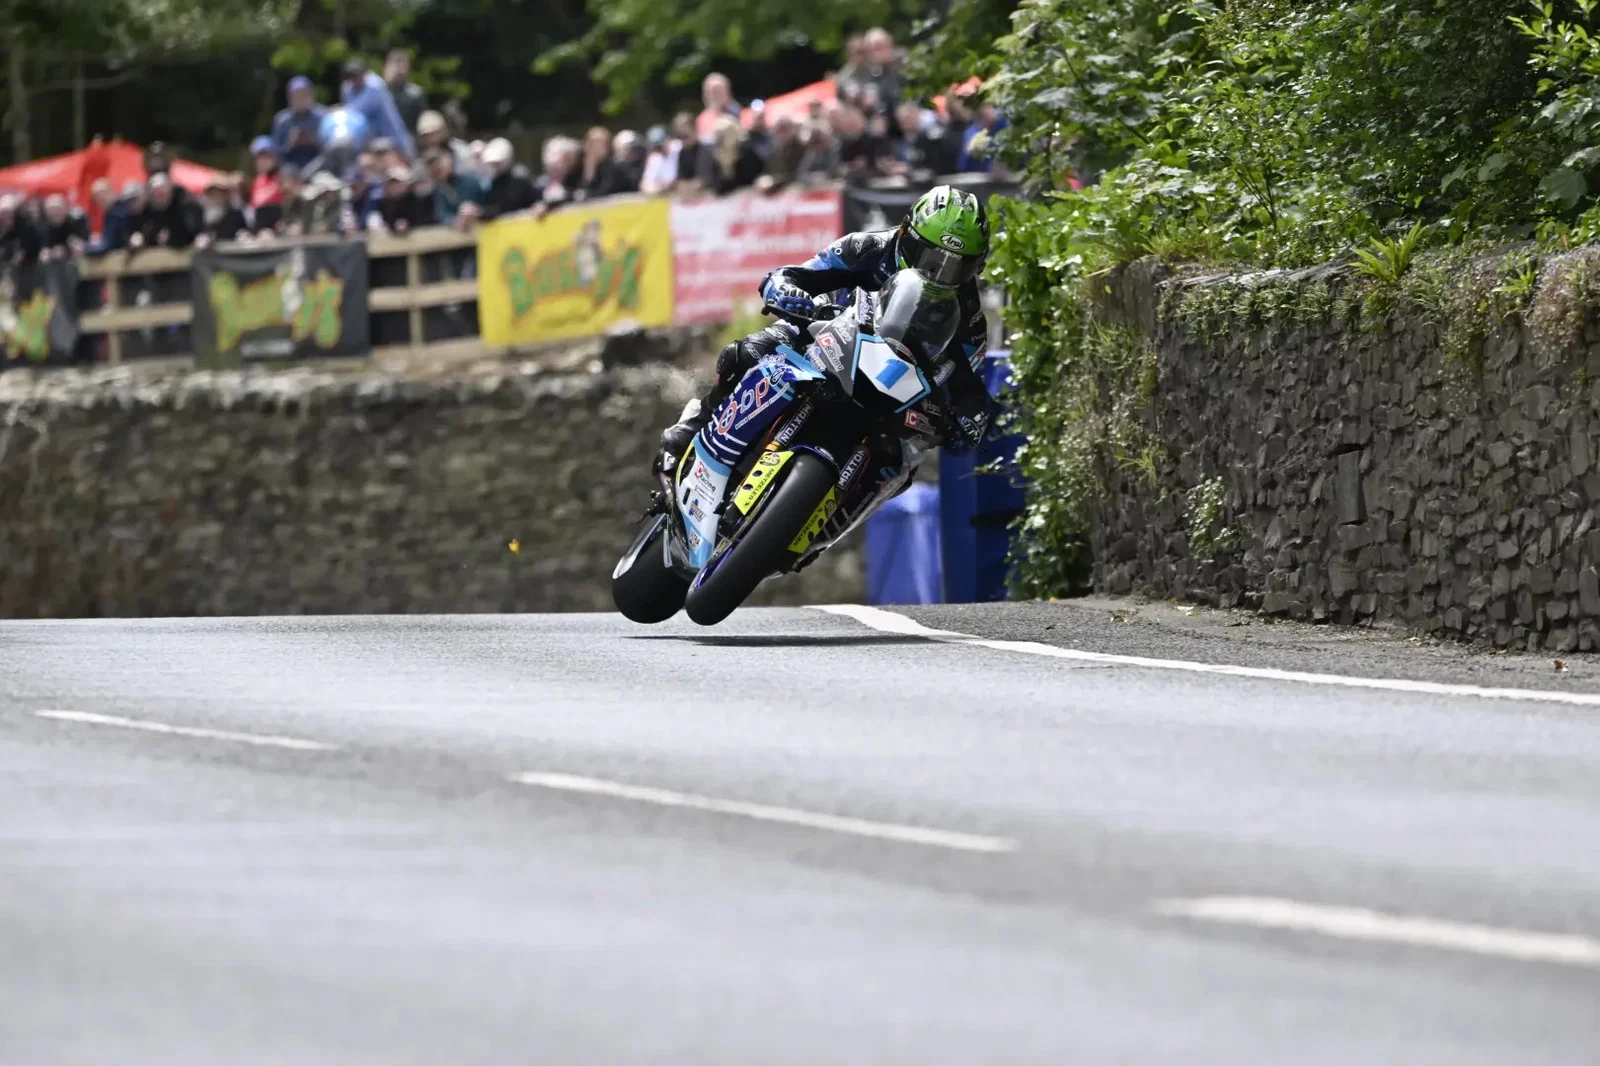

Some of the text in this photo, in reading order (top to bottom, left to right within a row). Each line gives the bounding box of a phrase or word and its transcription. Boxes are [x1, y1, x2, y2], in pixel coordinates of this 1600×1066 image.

[945, 237, 962, 248] Arai
[876, 359, 909, 390] 1
[780, 402, 812, 444] MAXTON
[748, 468, 775, 501] METZELER
